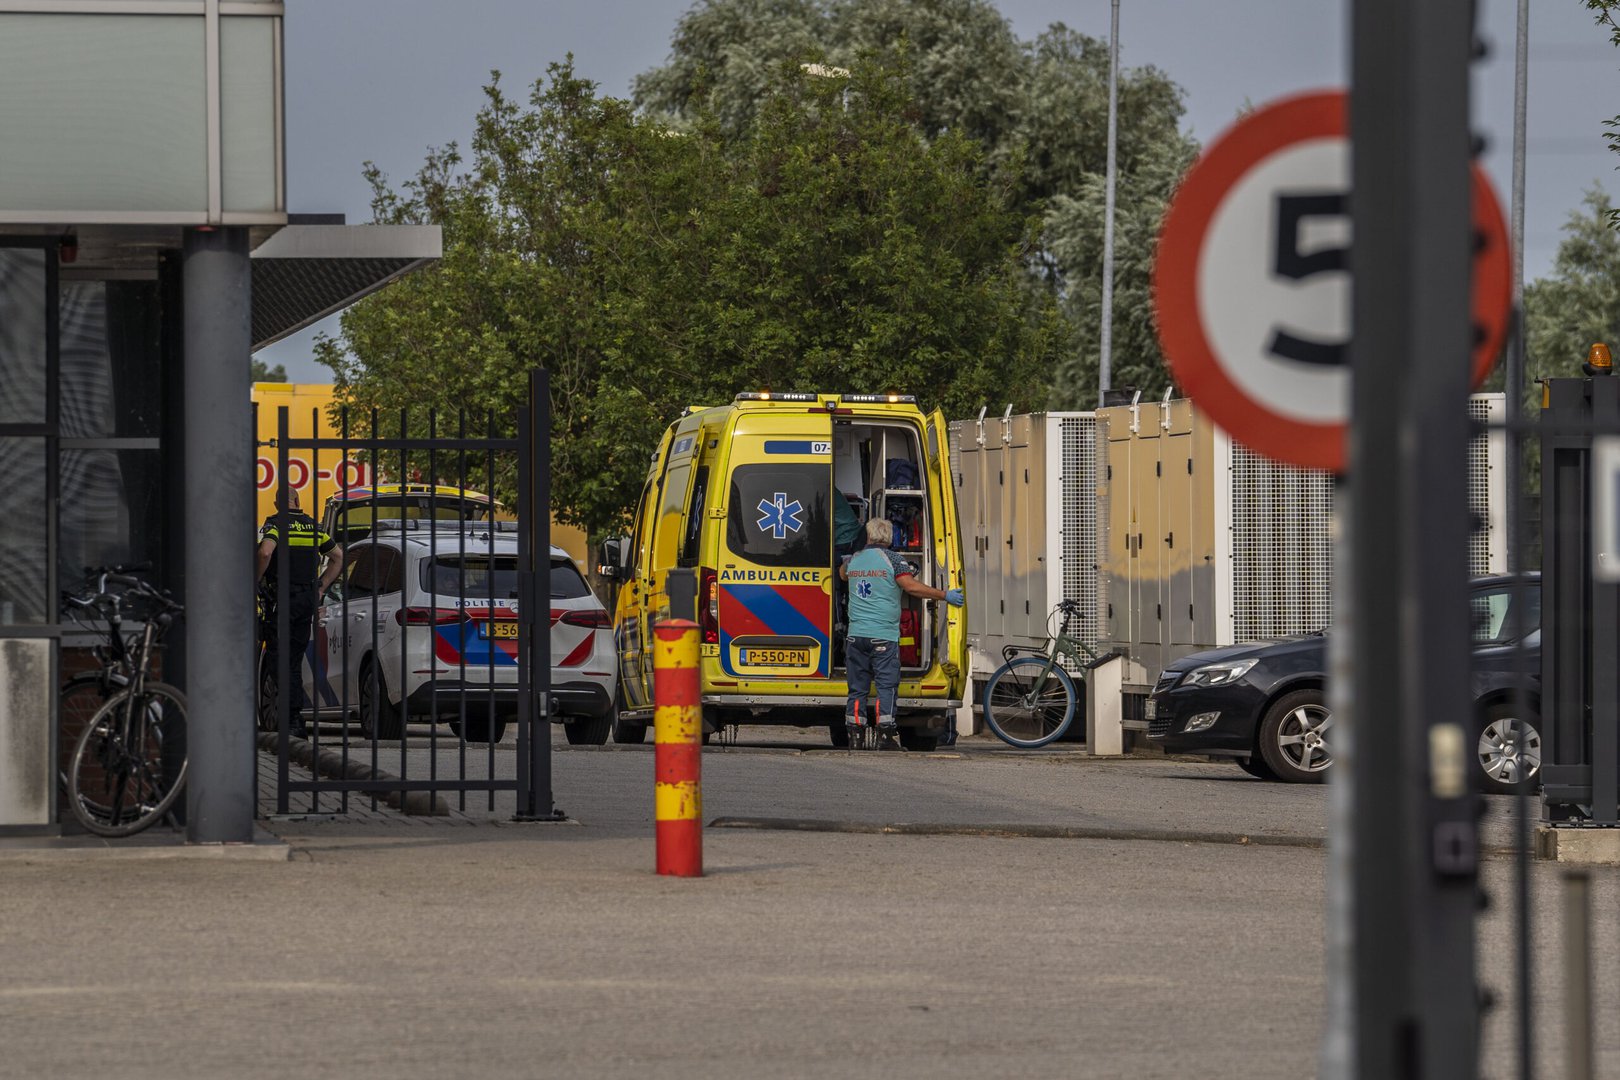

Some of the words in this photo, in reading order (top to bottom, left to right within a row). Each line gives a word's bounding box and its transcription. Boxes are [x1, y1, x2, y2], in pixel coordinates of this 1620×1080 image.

[1268, 194, 1352, 365] 5
[814, 443, 830, 452] 07-
[720, 570, 820, 582] AMBULANCE
[848, 569, 888, 578] MBULANCE
[492, 624, 518, 635] S-56
[749, 651, 805, 662] P-550-PN
